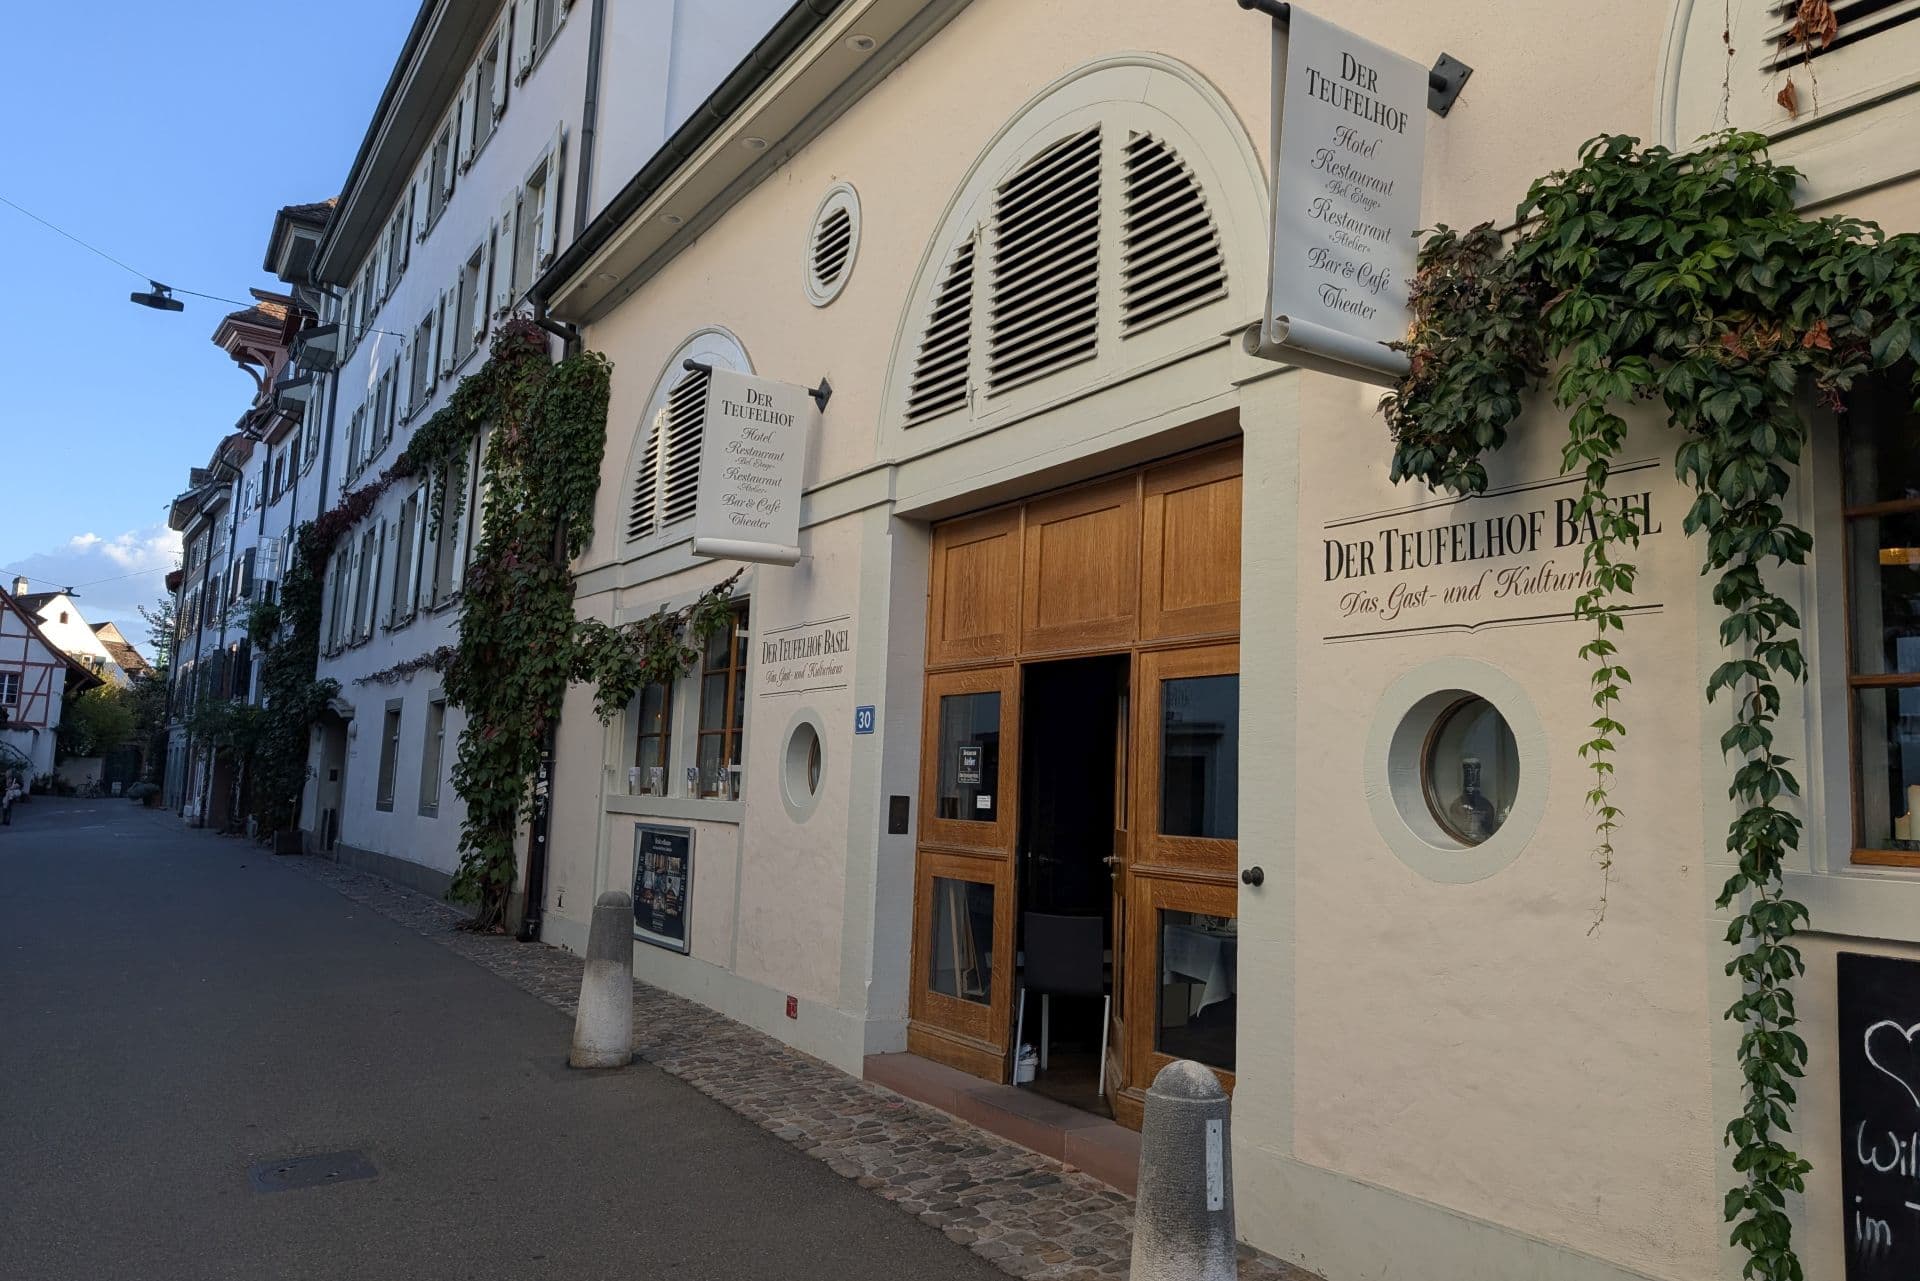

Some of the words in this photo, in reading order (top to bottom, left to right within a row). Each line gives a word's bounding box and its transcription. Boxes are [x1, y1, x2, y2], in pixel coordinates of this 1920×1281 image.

[1341, 51, 1379, 93] DER
[1305, 67, 1408, 135] TEUFELHOF
[1333, 124, 1383, 160] Hotel
[1310, 148, 1394, 197] Restaurant
[1307, 197, 1392, 246] Restaurant
[1307, 247, 1341, 274] Bar
[1341, 261, 1355, 278] &
[1357, 262, 1391, 295] Café
[1318, 282, 1378, 321] Theater
[722, 400, 795, 427] TEUFELHOF
[747, 388, 773, 408] DER
[725, 440, 785, 461] Restaurant
[741, 427, 775, 444] Hotel
[722, 466, 783, 488] Restaurant
[721, 493, 745, 507] Bar
[745, 498, 755, 508] &
[756, 497, 782, 515] Café
[728, 512, 771, 529] Theater
[1323, 538, 1376, 582] DER
[1379, 510, 1545, 574] TEUFELHOF
[1339, 590, 1378, 618] Das
[1379, 582, 1438, 621] Gast-
[1441, 568, 1492, 604] und
[1494, 560, 1603, 598] Kulturh
[762, 641, 778, 664] DER
[778, 634, 823, 662] TEUFELHOF
[824, 629, 850, 655] BASEL
[858, 711, 871, 729] 30
[1857, 1119, 1920, 1176] Wil
[1855, 1195, 1892, 1247] im
